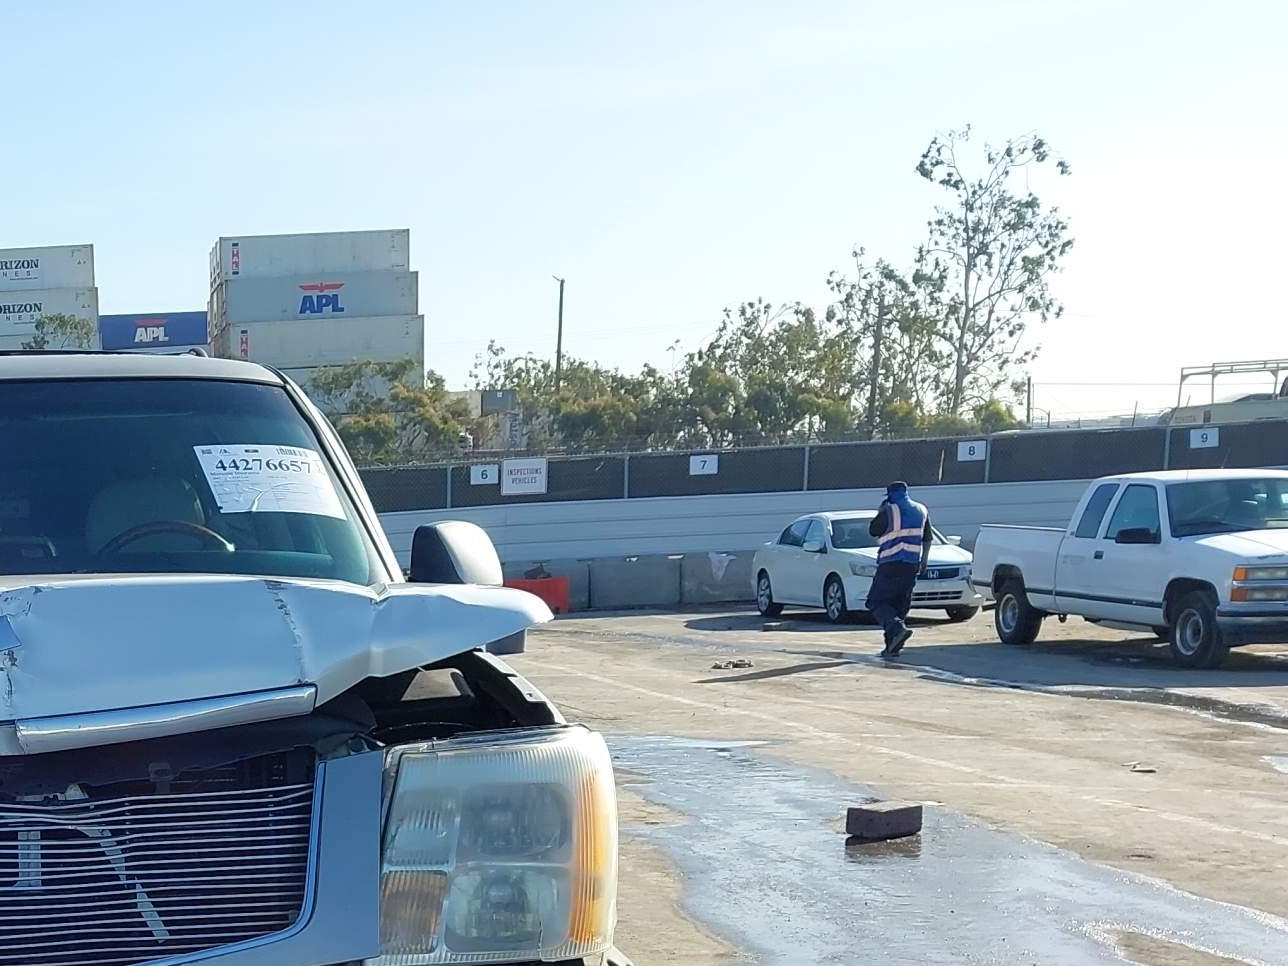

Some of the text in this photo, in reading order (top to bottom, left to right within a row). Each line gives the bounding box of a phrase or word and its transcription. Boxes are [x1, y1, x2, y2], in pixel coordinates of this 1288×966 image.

[299, 294, 345, 314] APL
[134, 327, 169, 342] APL
[1200, 432, 1209, 443] 9
[968, 445, 976, 456] 8
[215, 458, 311, 473] 44276657
[700, 459, 708, 470] 7
[480, 469, 489, 480] 6
